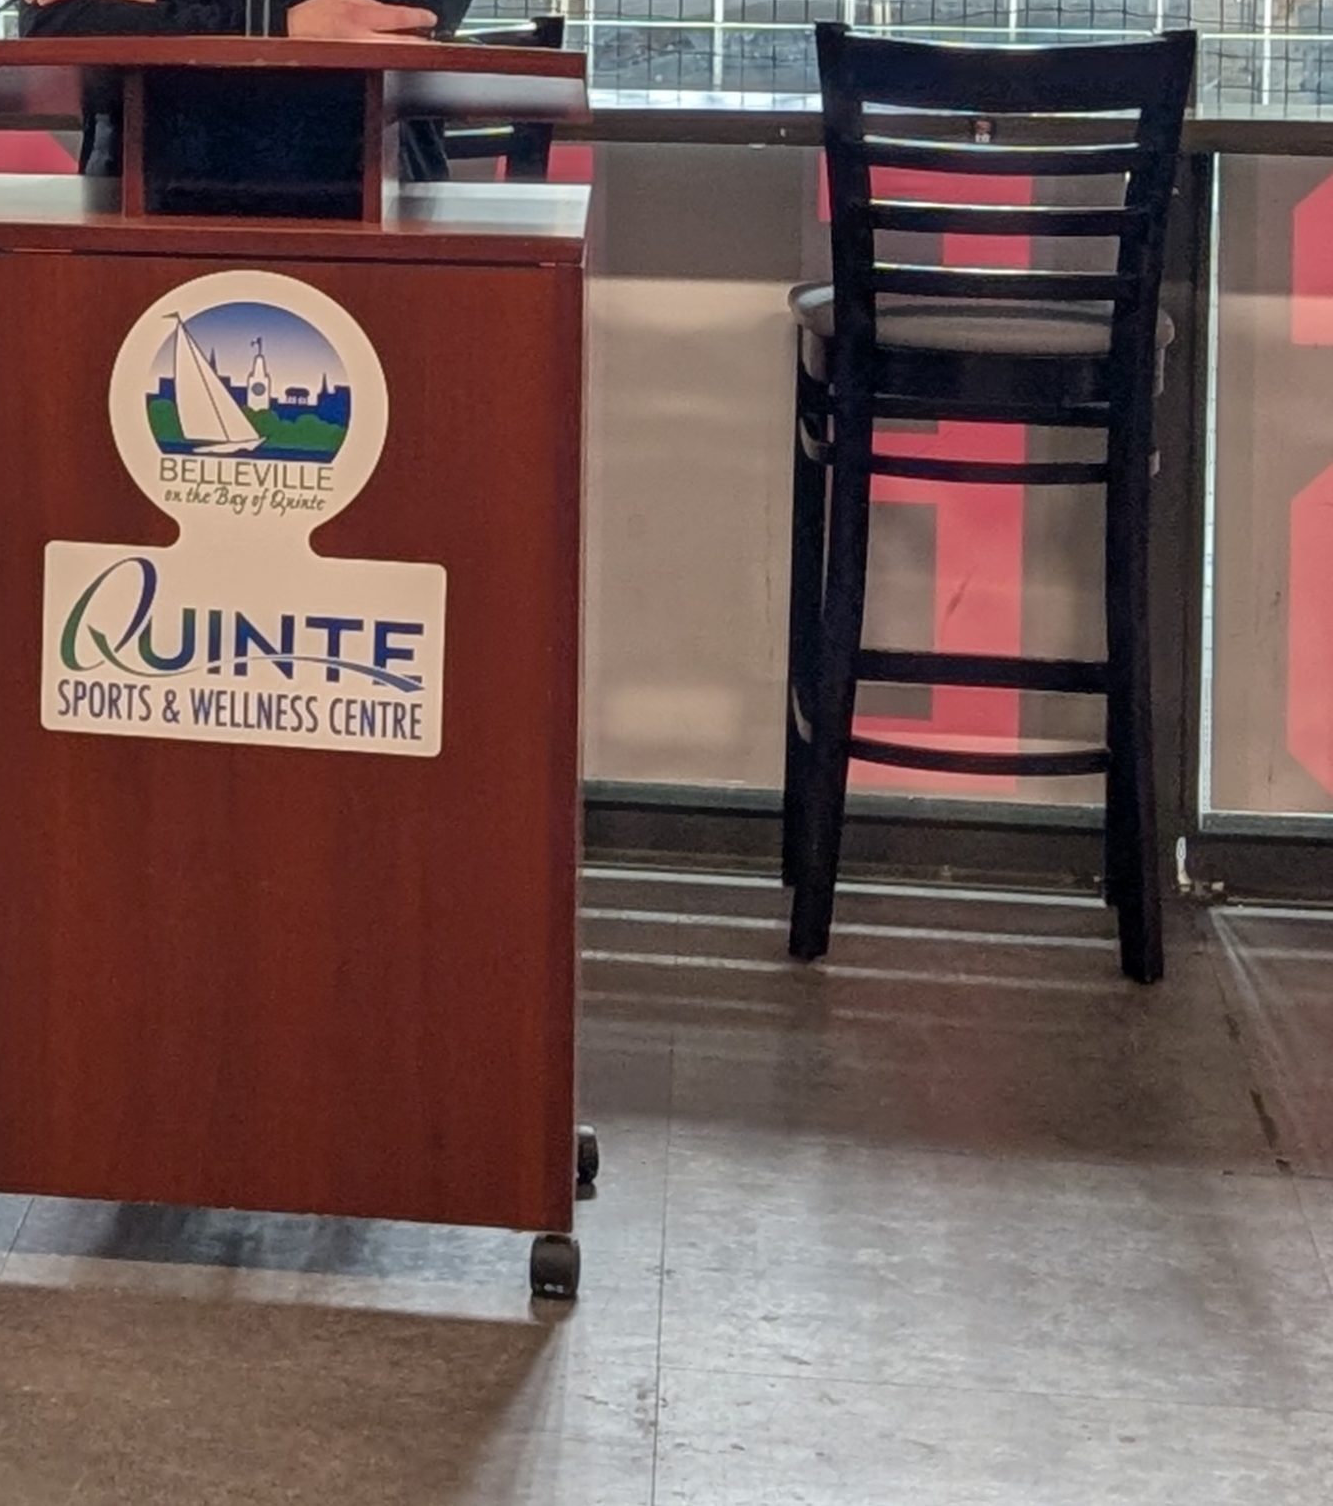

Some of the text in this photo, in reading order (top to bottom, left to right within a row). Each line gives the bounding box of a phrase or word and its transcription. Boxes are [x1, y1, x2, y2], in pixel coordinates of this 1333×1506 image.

[160, 457, 333, 491] BELLEVILLE
[165, 483, 326, 516] on the Bay of Quinte
[58, 678, 423, 740] SPORTS & WELLNESS CENTRE
